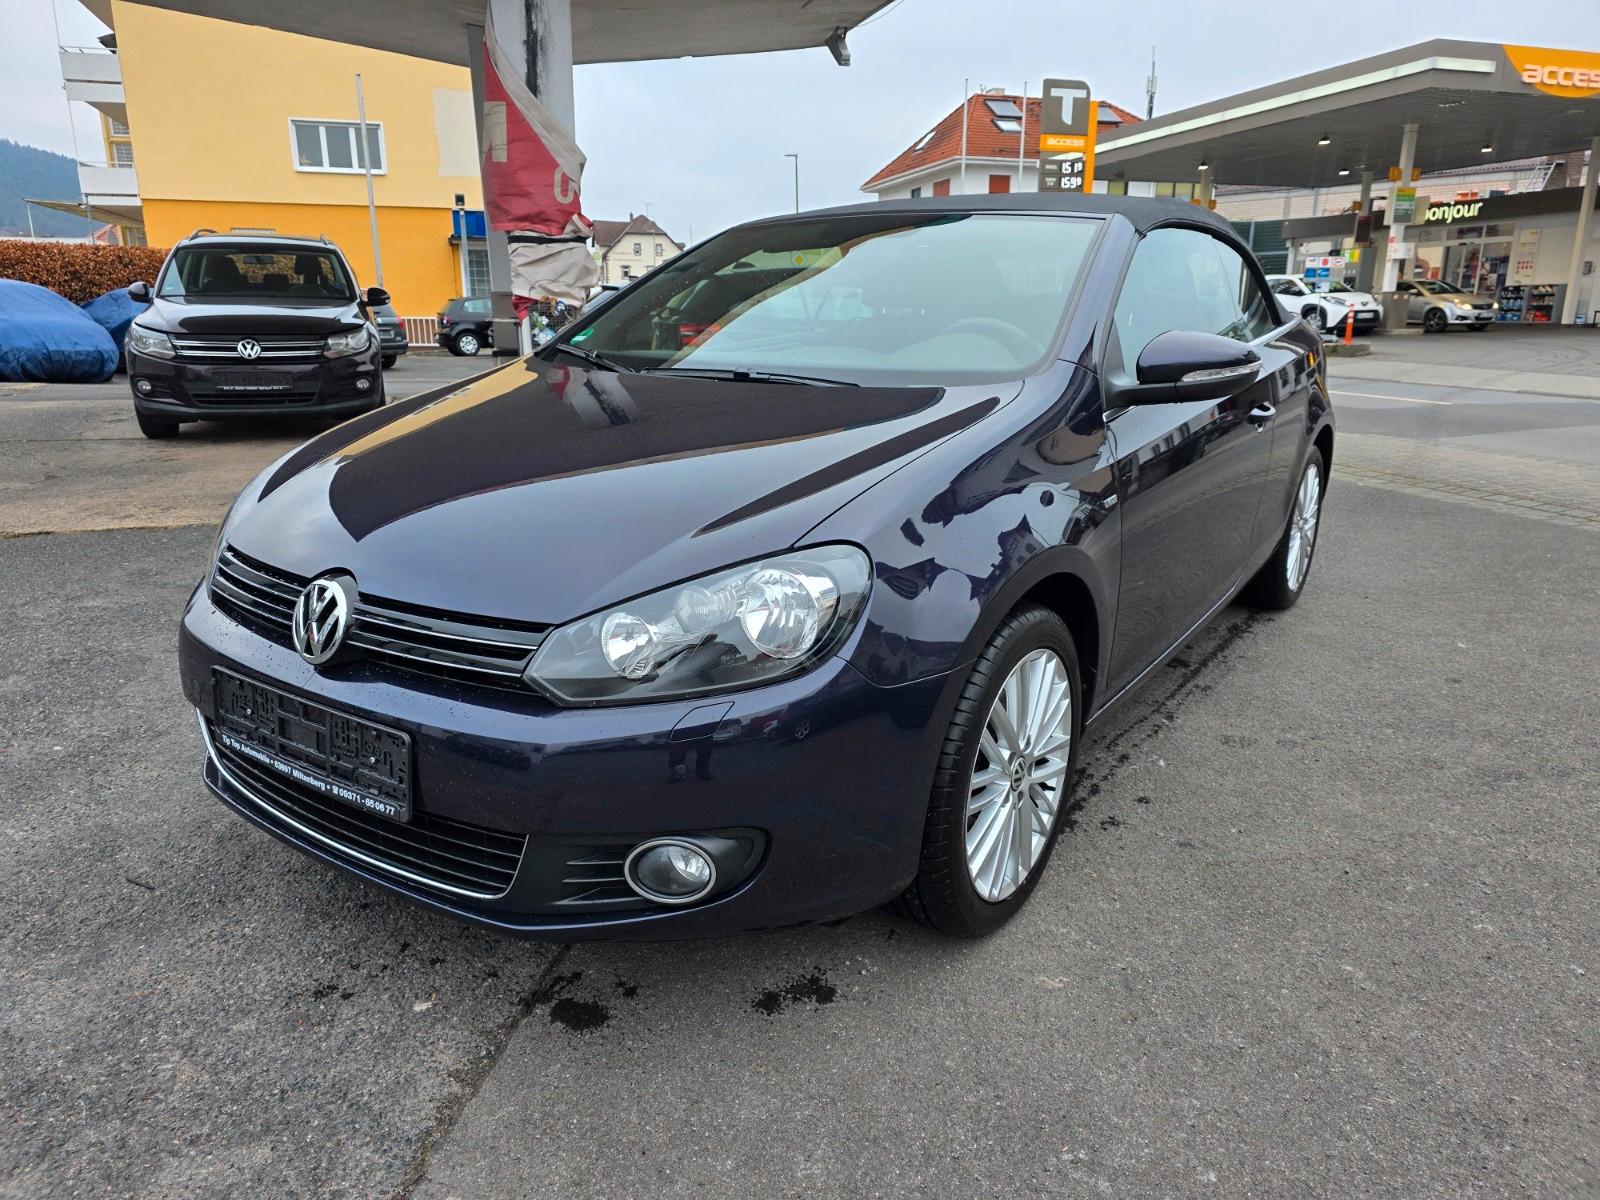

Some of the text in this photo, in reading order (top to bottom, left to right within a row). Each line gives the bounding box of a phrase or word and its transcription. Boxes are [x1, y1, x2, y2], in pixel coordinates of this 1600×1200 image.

[1050, 88, 1087, 125] T
[222, 734, 231, 746] Tip
[230, 738, 241, 751] Top
[240, 743, 270, 764] Automobile
[292, 768, 326, 791] Miltenberg
